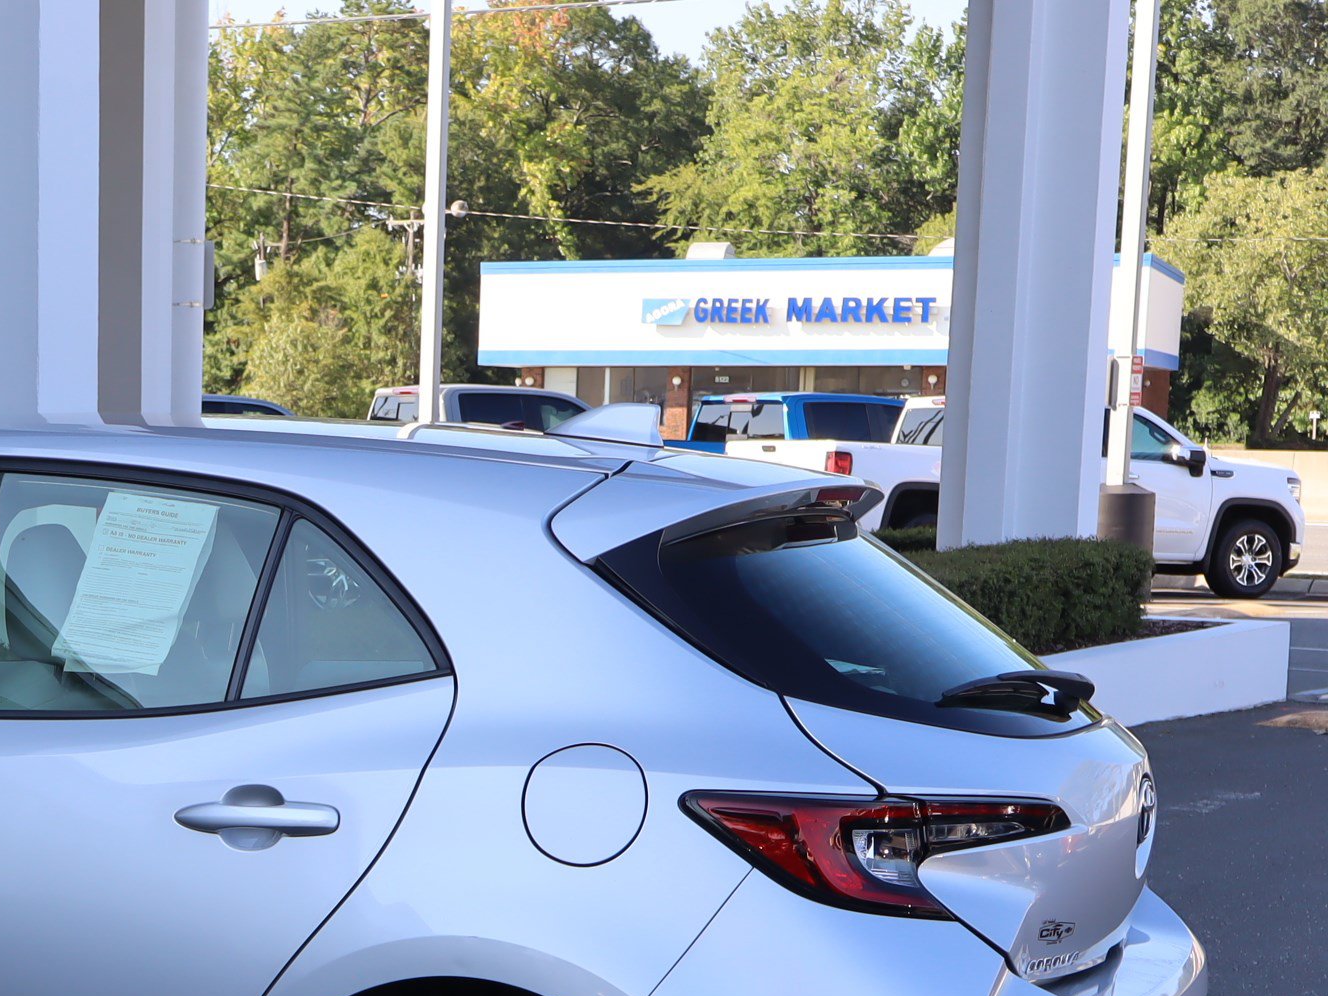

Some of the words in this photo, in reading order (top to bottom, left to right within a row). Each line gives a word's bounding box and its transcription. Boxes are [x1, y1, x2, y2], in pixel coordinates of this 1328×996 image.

[694, 298, 770, 324] GREEK
[786, 297, 937, 323] MARKET
[136, 508, 160, 516] BUYERS
[161, 510, 179, 519] GUIDE
[137, 535, 158, 543] DEALER
[158, 538, 188, 546] WARRANTY
[106, 546, 127, 554] DEALER
[127, 549, 157, 558] WARRANTY
